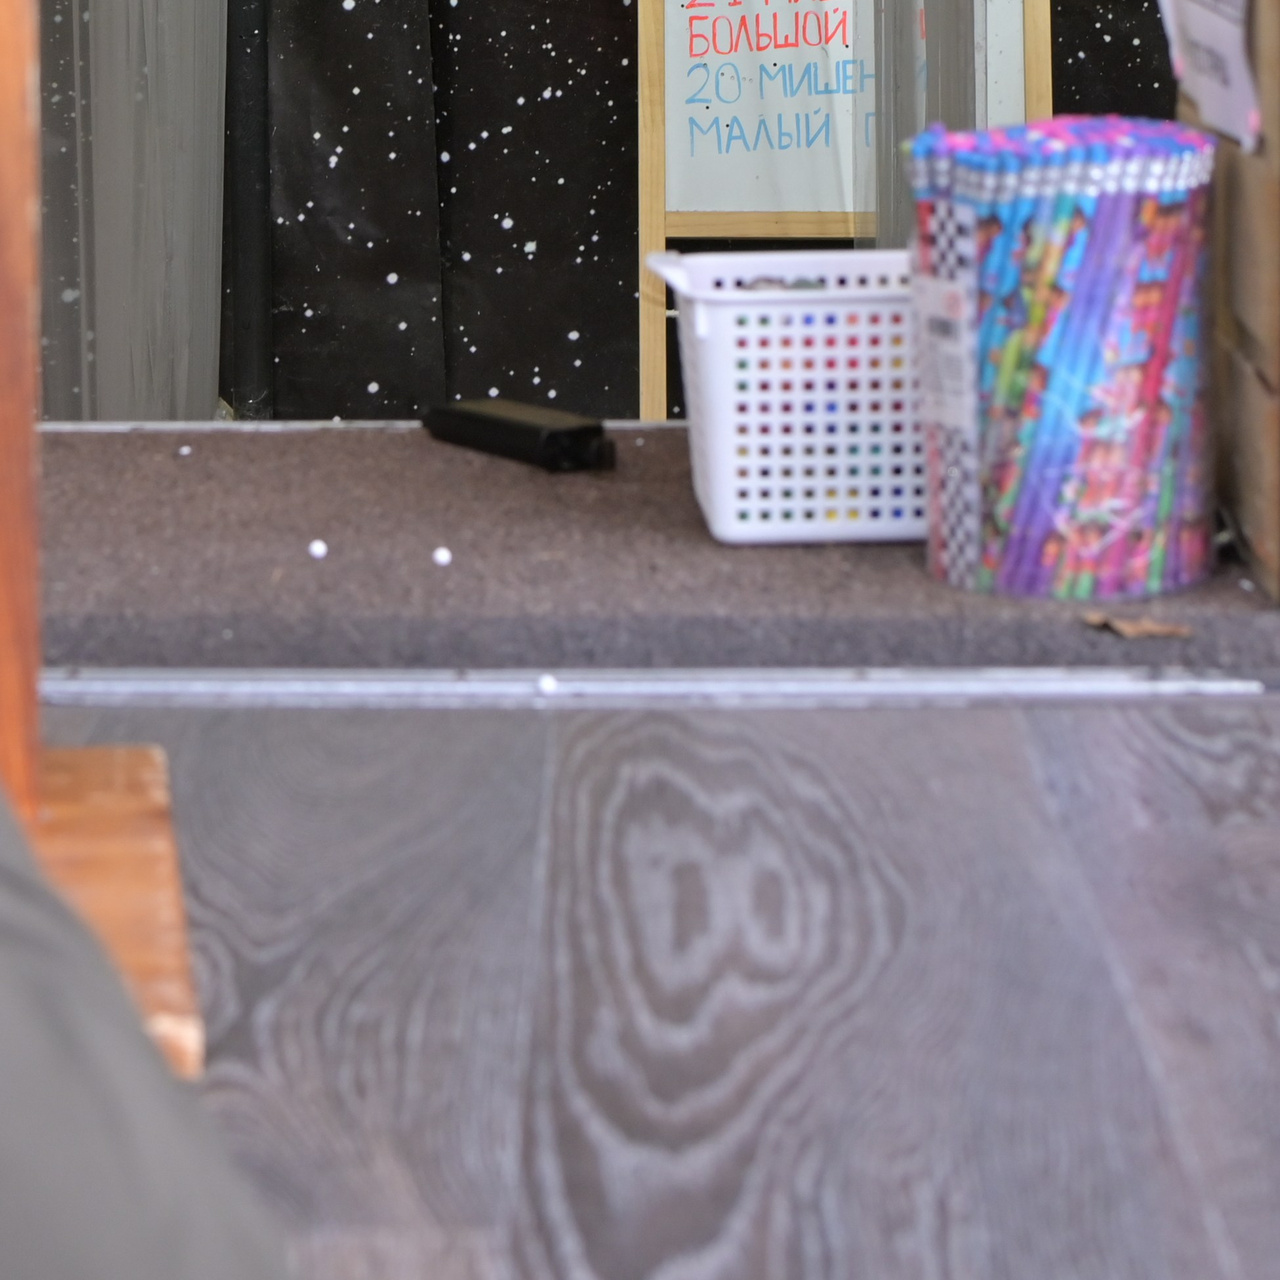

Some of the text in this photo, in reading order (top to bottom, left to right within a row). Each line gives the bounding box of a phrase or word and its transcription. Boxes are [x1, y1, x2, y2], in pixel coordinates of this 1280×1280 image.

[689, 7, 848, 58] БОЛЬШОЙ
[685, 62, 742, 105] 20
[688, 107, 831, 158] МАЛЫЙ
